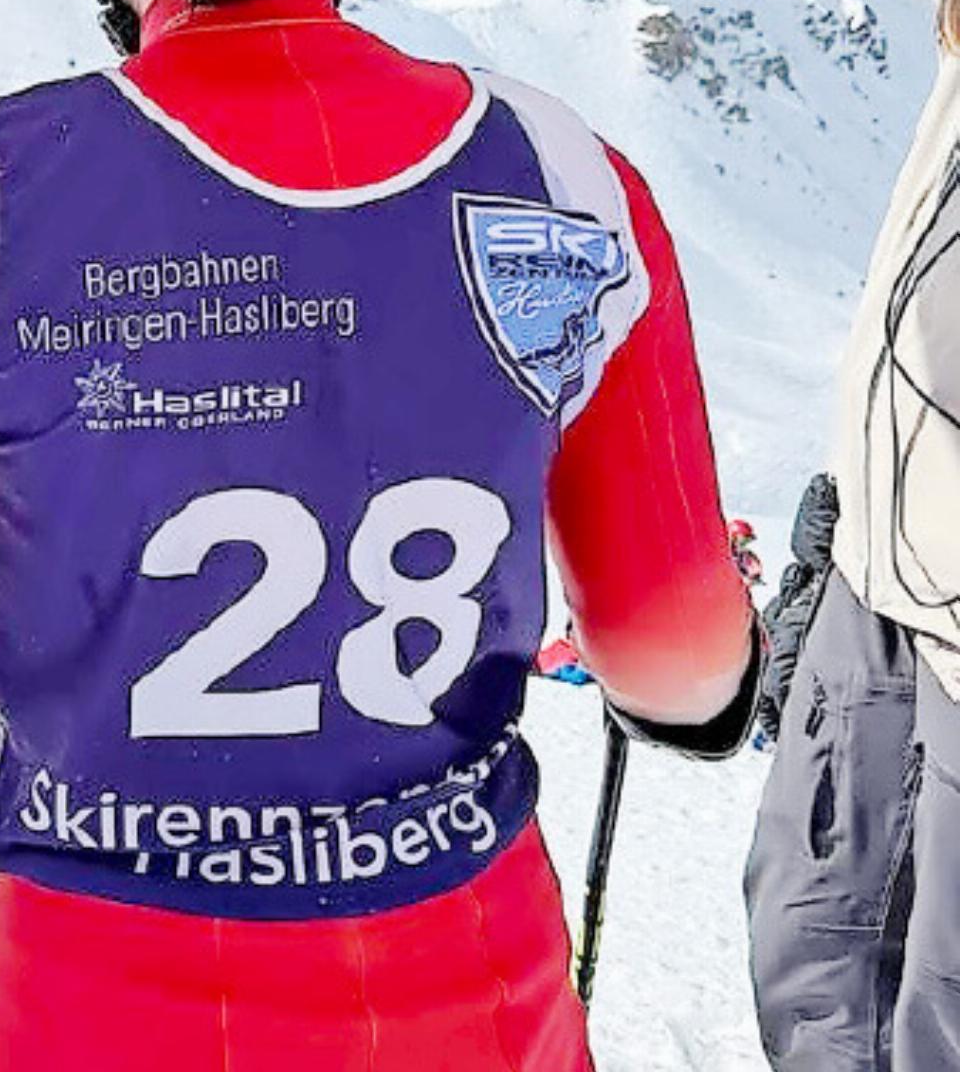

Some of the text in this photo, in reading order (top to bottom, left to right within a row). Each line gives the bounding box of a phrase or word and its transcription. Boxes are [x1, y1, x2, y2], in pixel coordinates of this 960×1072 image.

[84, 251, 279, 299] Bergbahnen
[16, 294, 356, 353] Meiringen-Hasliberg
[133, 380, 301, 415] Haslital
[130, 477, 513, 737] 28
[132, 790, 497, 886] asliberg
